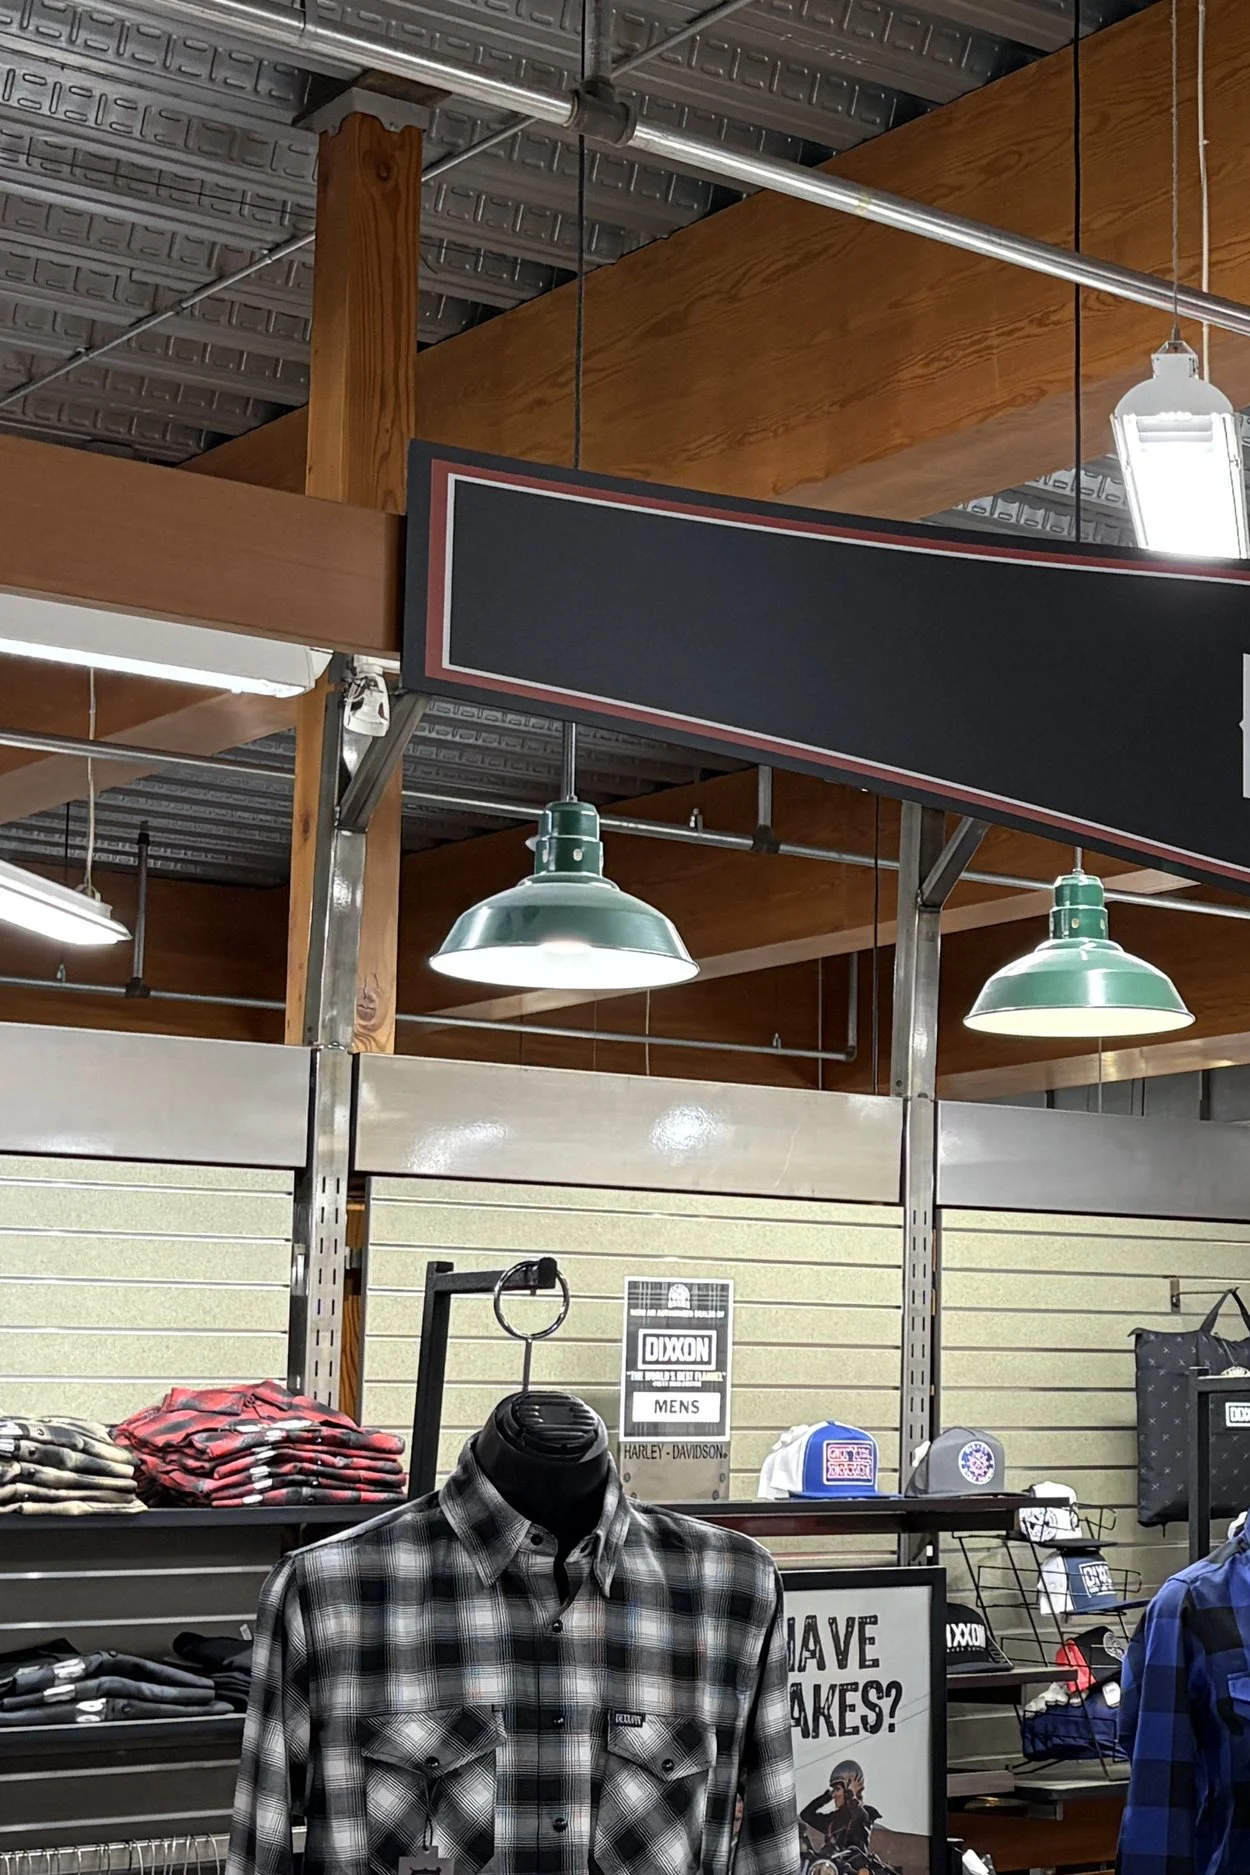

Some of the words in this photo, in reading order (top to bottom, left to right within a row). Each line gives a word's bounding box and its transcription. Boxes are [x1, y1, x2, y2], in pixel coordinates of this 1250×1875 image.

[645, 1336, 709, 1362] DIXXON
[654, 1399, 700, 1414] MENS
[624, 1444, 664, 1460] HARLEY
[789, 1680, 903, 1739] AKES?
